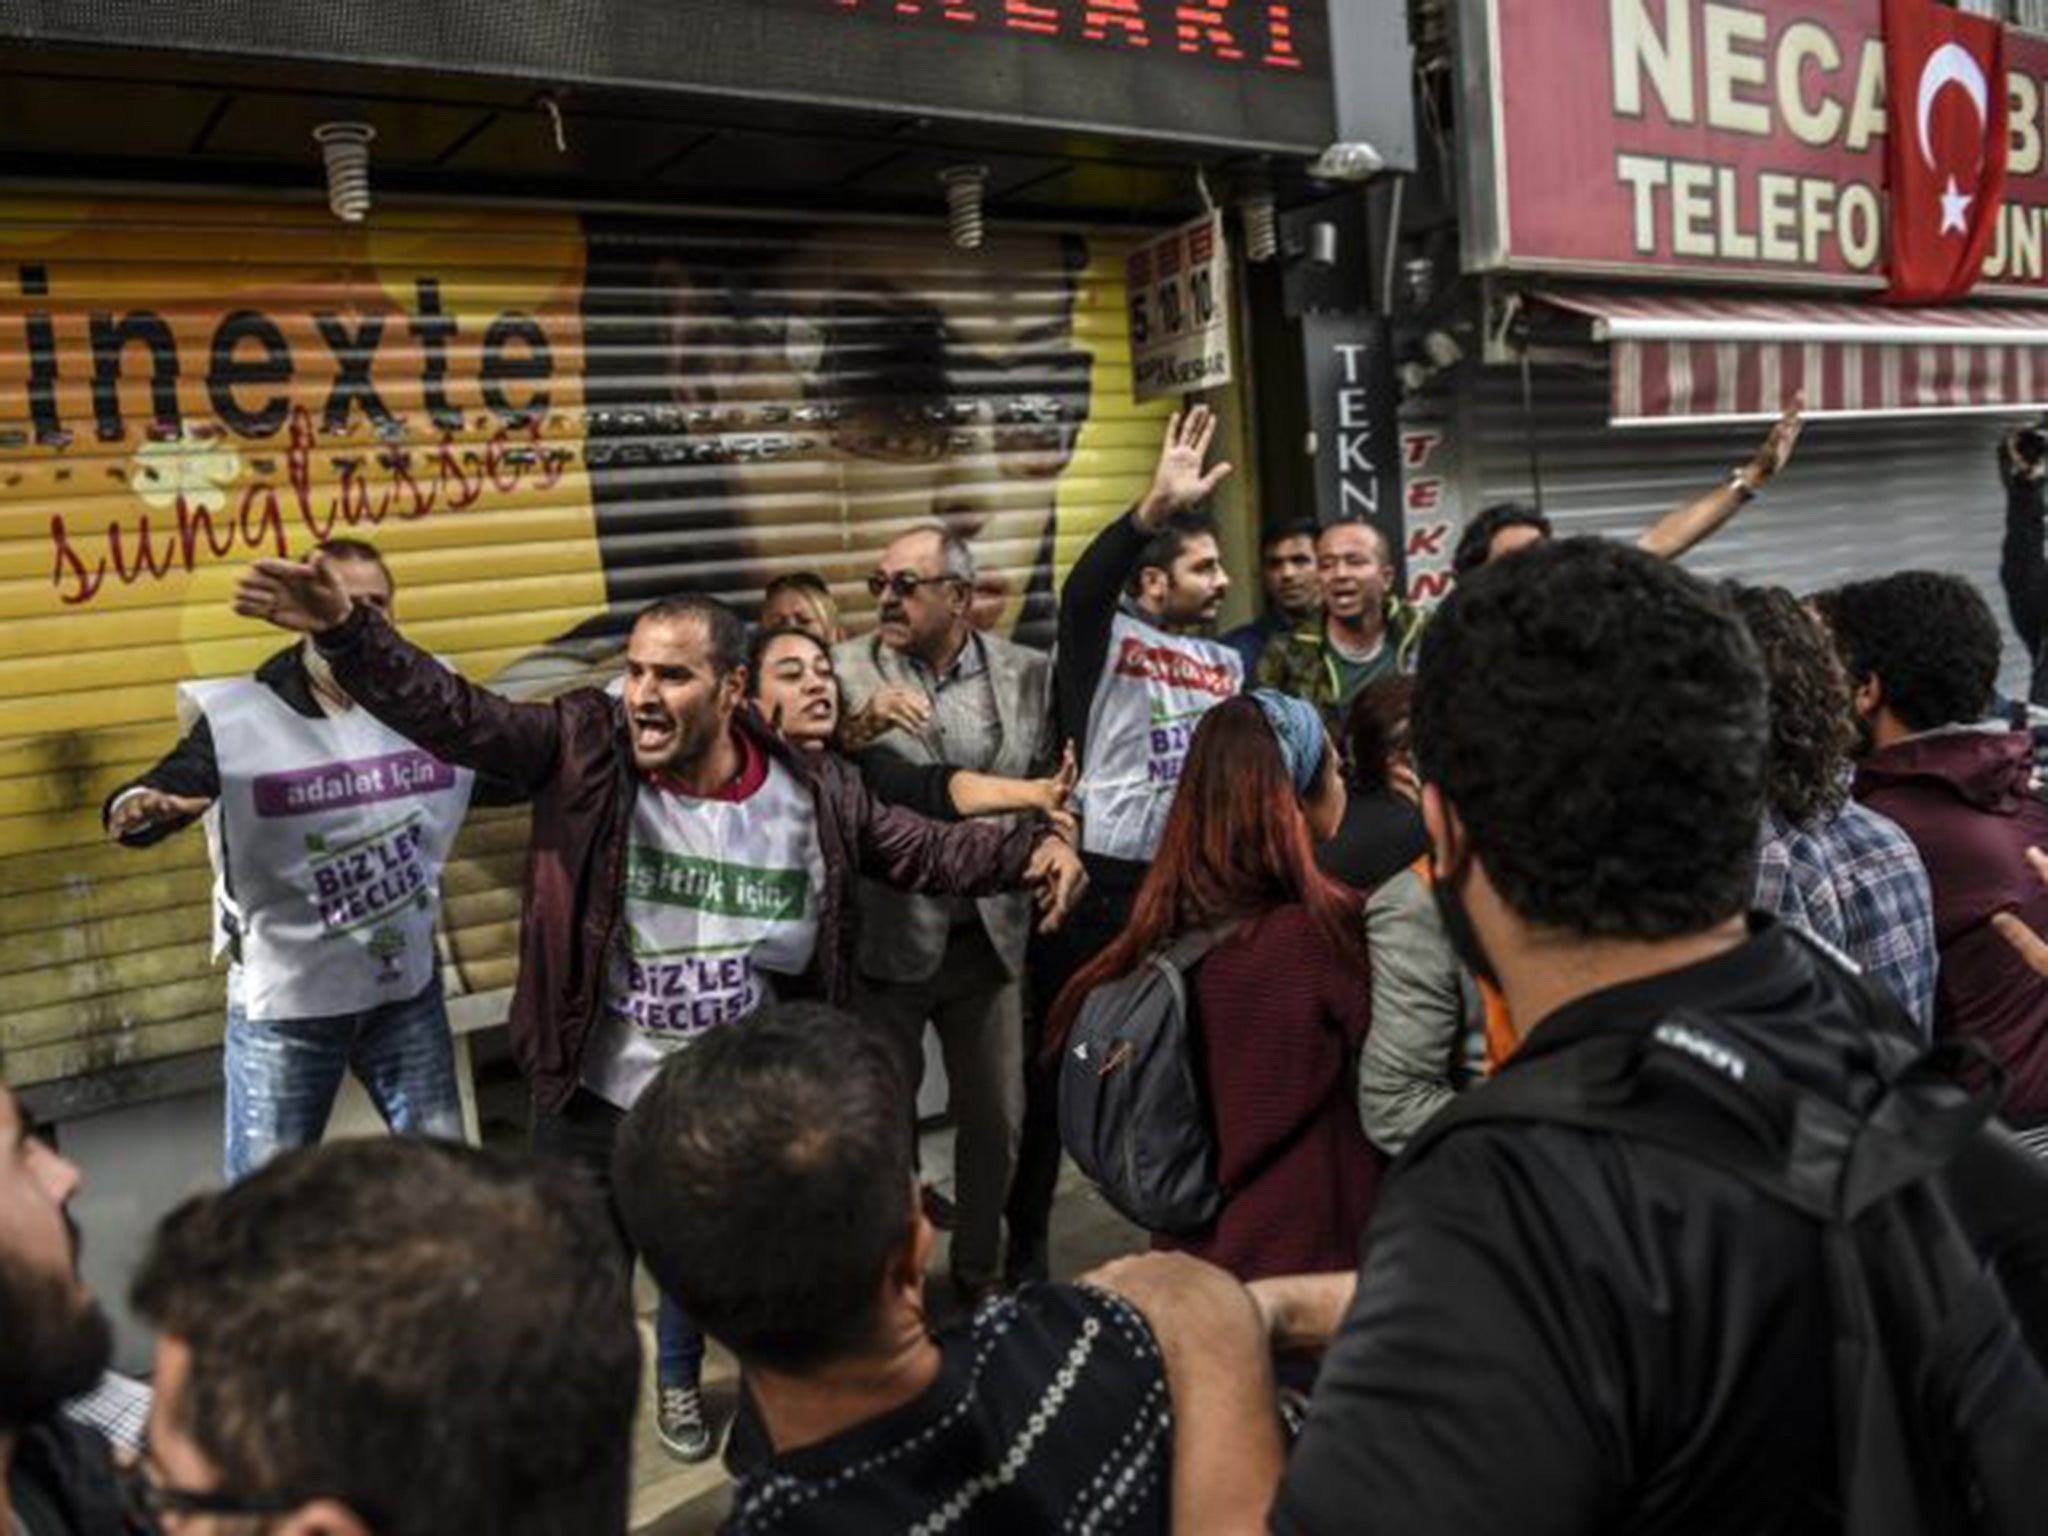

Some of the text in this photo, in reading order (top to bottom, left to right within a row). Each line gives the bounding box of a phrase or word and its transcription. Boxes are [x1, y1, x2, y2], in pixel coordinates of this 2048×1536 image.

[1616, 155, 1880, 270] TELEFO
[0, 263, 557, 447] inexte
[1333, 344, 1379, 514] TEKN
[1404, 434, 1454, 602] TEKN
